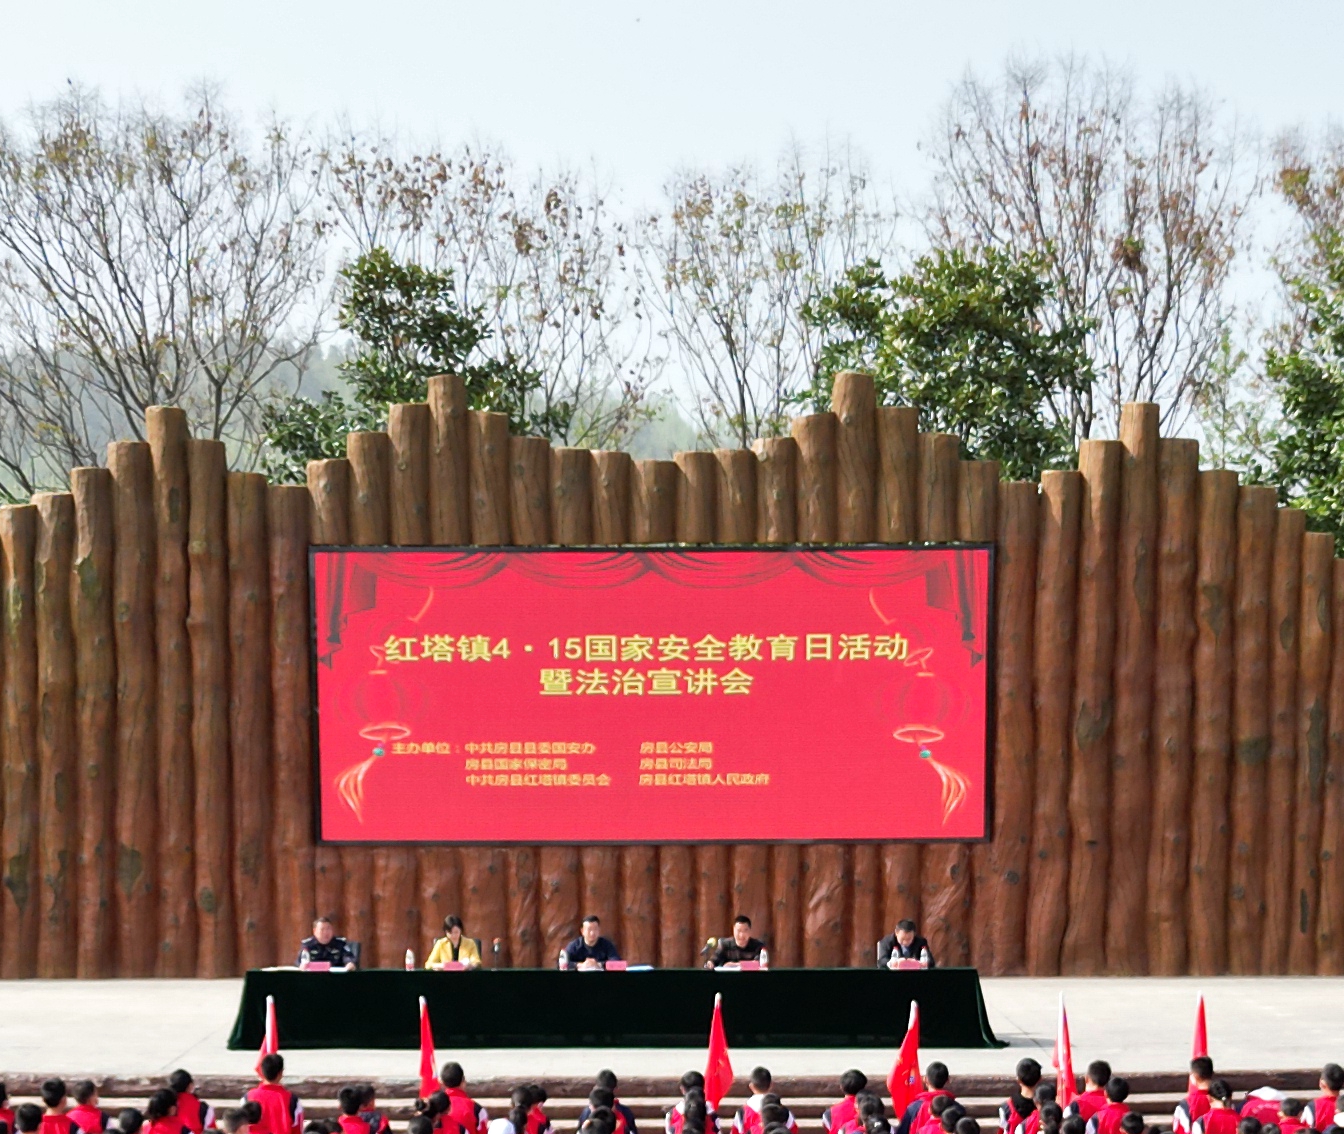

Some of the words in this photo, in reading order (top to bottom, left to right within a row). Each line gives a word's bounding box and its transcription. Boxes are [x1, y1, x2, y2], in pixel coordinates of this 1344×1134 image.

[540, 667, 754, 696] 暨法治宣讲会
[639, 741, 713, 754] 房县公安局
[639, 757, 713, 770] 房县司法局
[639, 773, 770, 786] 房县红塔镇人民政府
